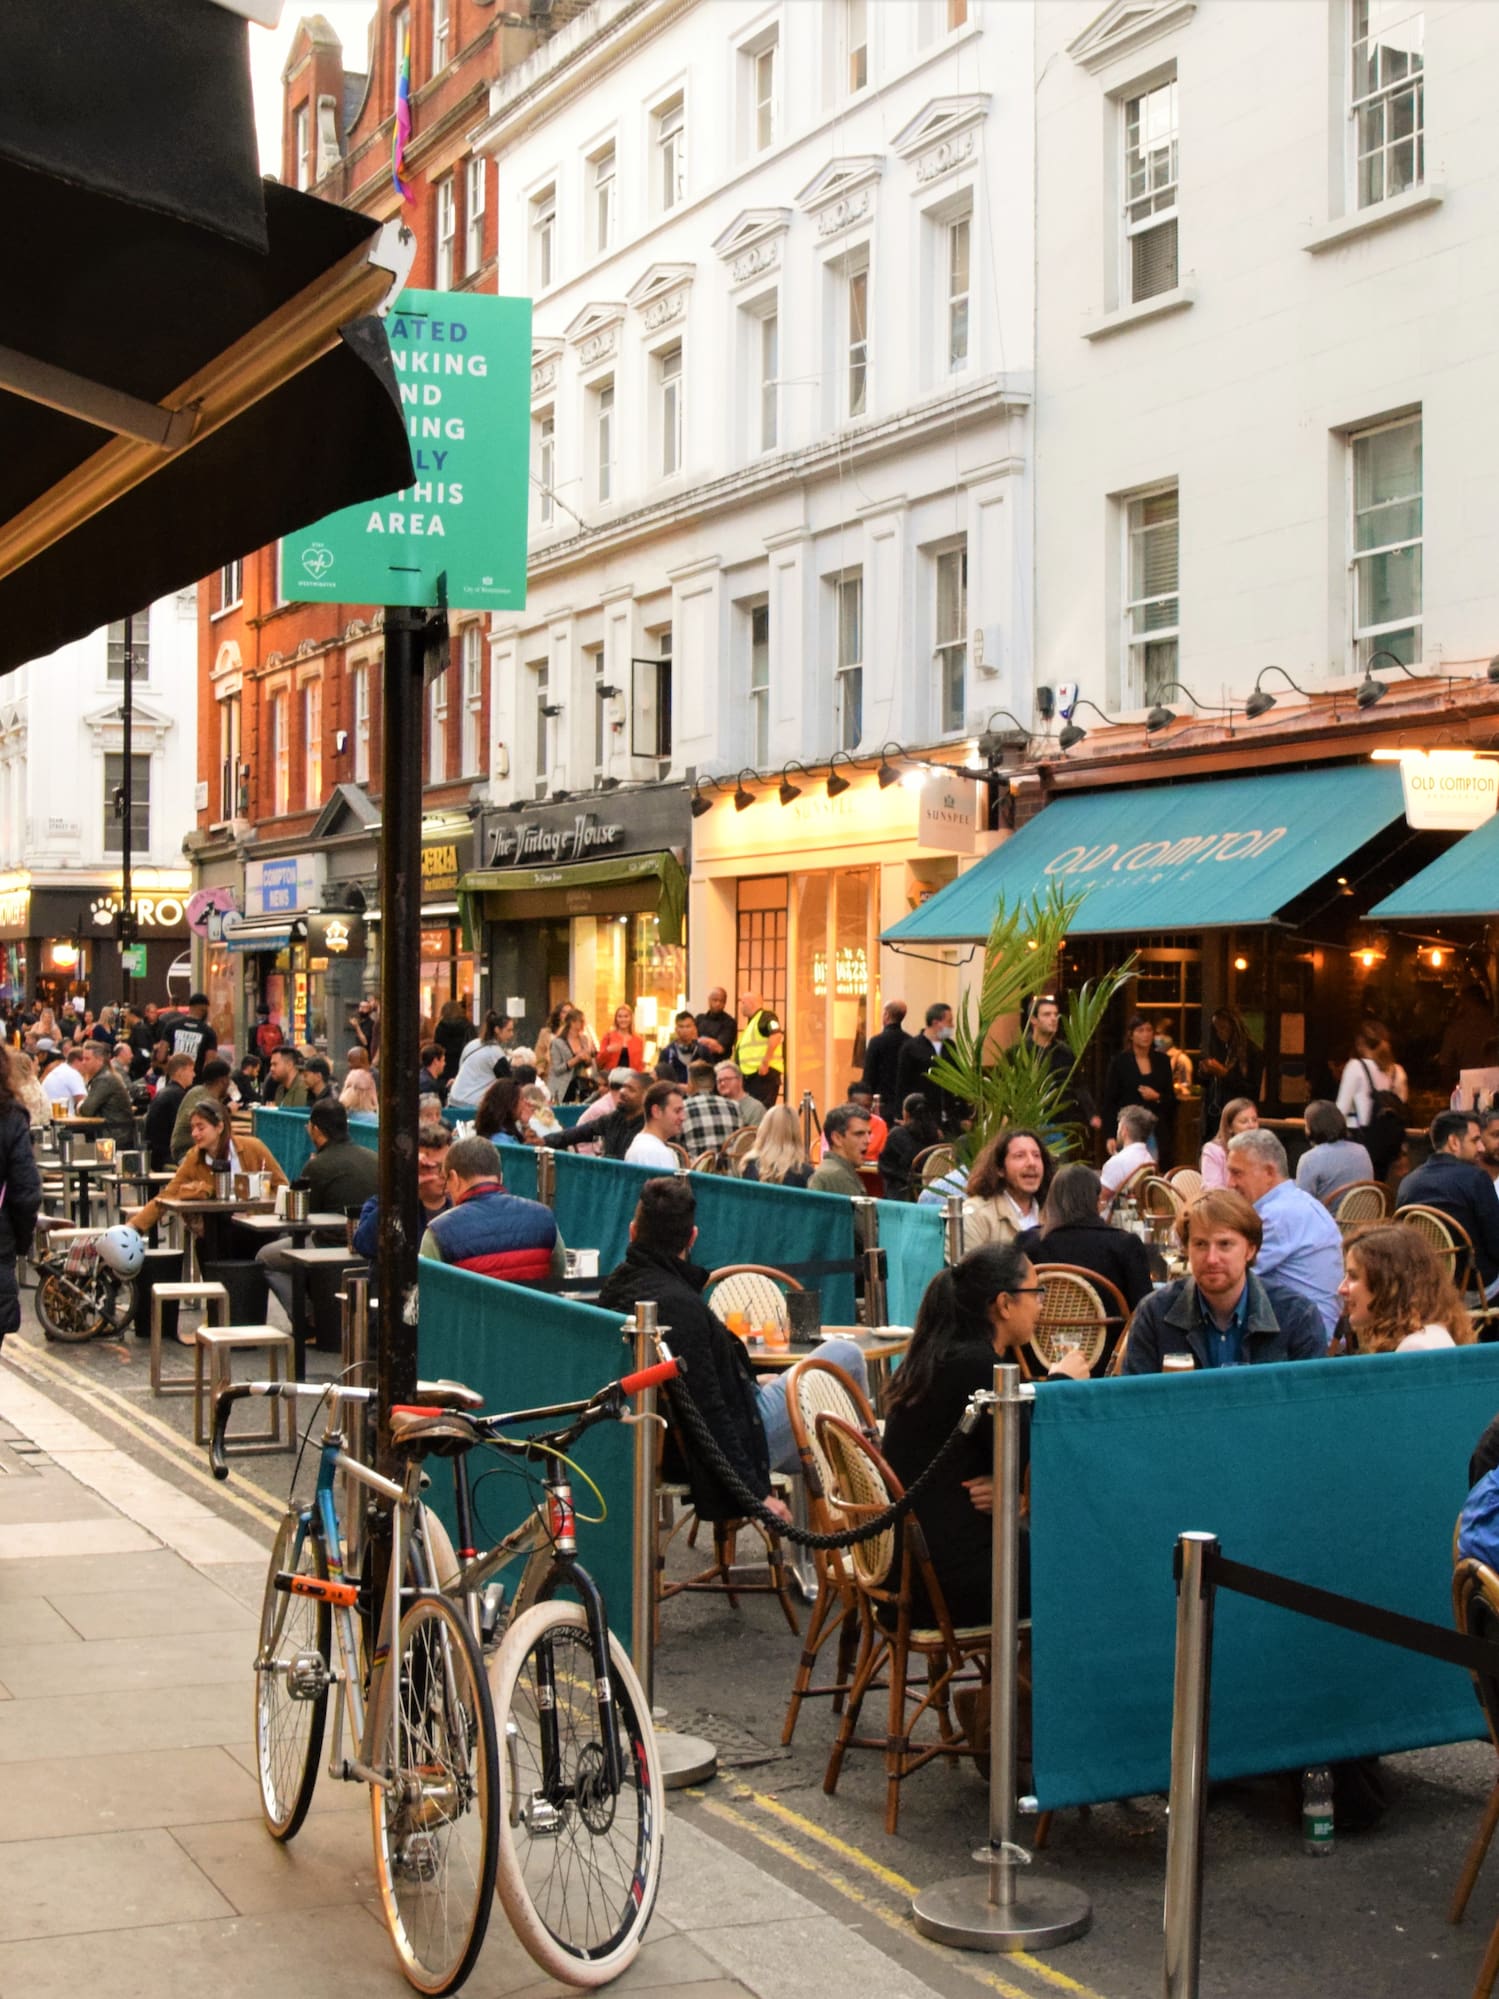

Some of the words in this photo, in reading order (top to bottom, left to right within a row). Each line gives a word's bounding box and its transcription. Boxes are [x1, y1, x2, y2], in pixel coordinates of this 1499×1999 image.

[383, 318, 468, 342] ATED
[391, 350, 487, 377] NKING
[410, 415, 465, 440] ING
[416, 449, 448, 471] LY
[366, 511, 446, 537] AREA
[1411, 775, 1436, 791] OLD
[1439, 776, 1495, 793] COMPTON
[926, 809, 970, 826] SUNSPEL
[487, 827, 518, 866] The
[513, 824, 575, 864] Vintage
[571, 815, 624, 859] House
[1044, 844, 1119, 875] OLD
[1112, 826, 1287, 872] COMPTON
